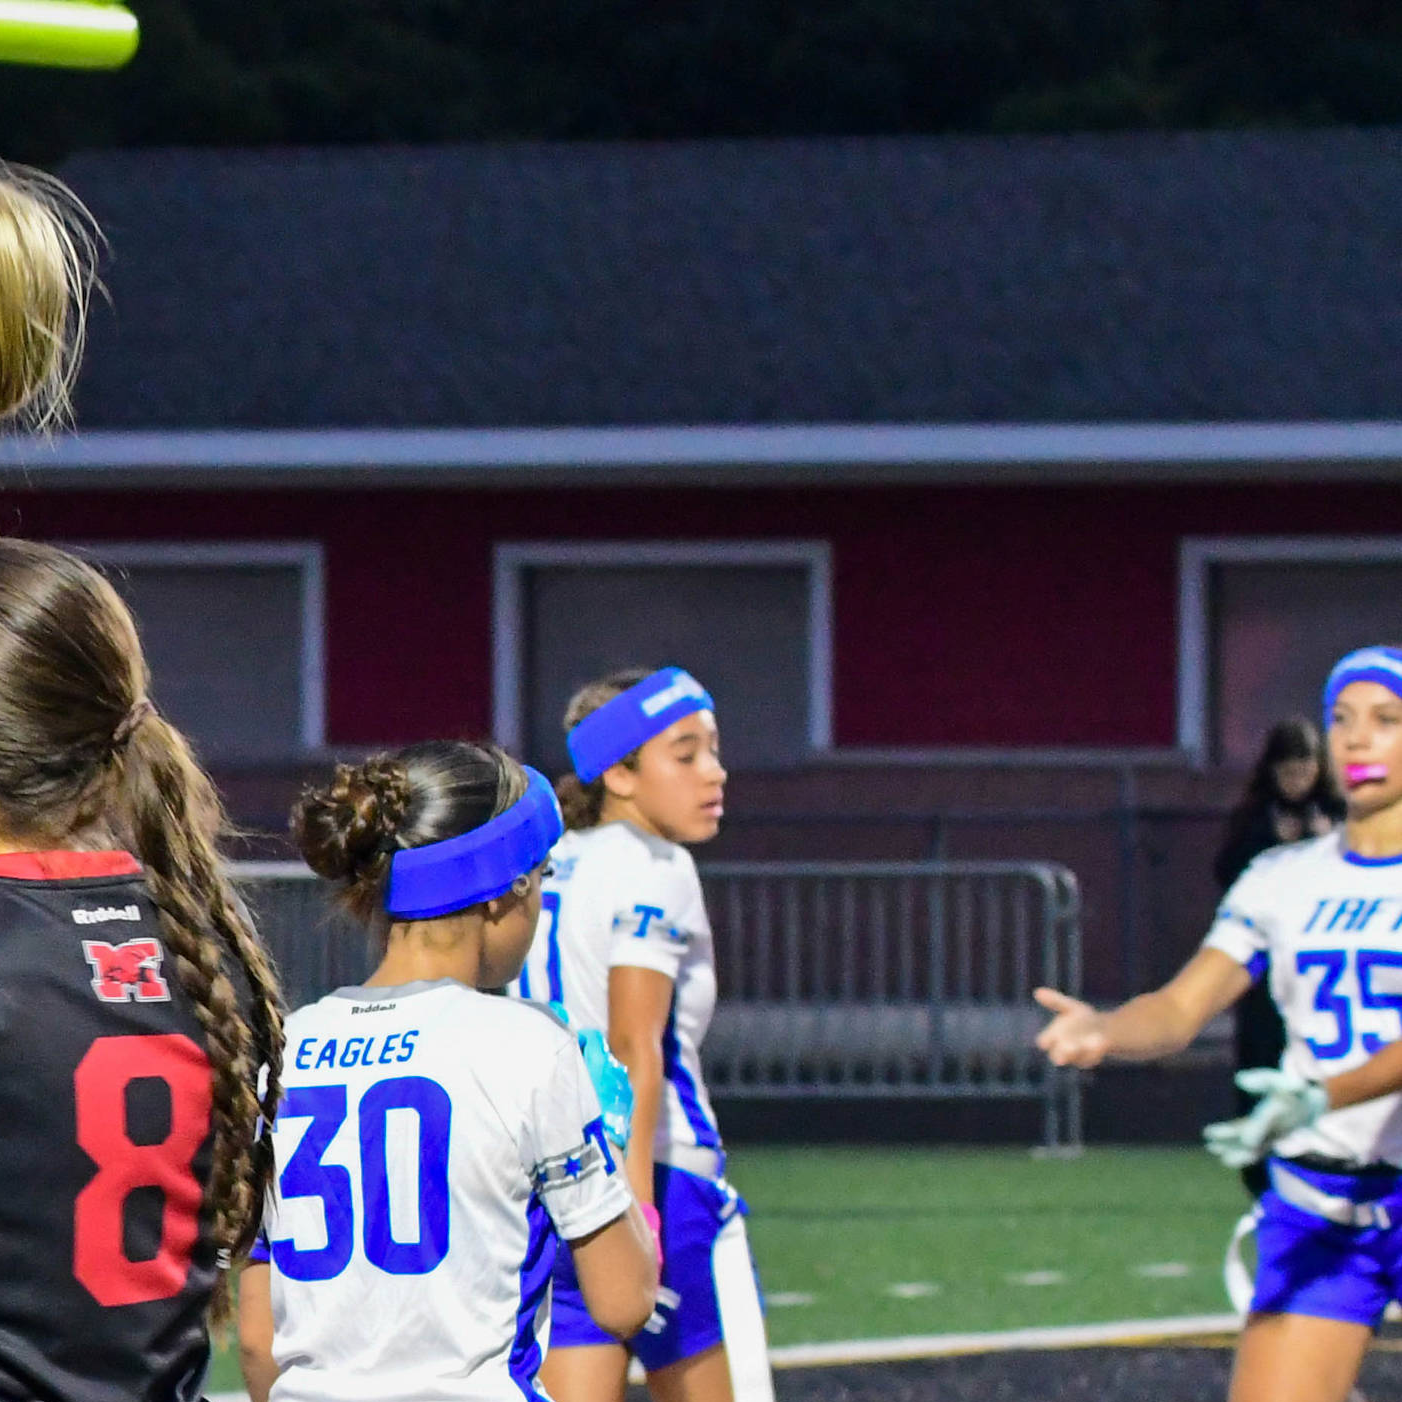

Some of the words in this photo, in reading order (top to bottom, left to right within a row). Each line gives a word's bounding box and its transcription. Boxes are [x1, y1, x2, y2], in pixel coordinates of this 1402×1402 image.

[633, 904, 665, 938] T
[1302, 897, 1402, 933] TAF
[351, 1003, 397, 1015] Riddell
[1296, 949, 1402, 1060] 35
[295, 1030, 420, 1070] EAGLES
[73, 1034, 213, 1307] 8
[272, 1076, 452, 1282] 30
